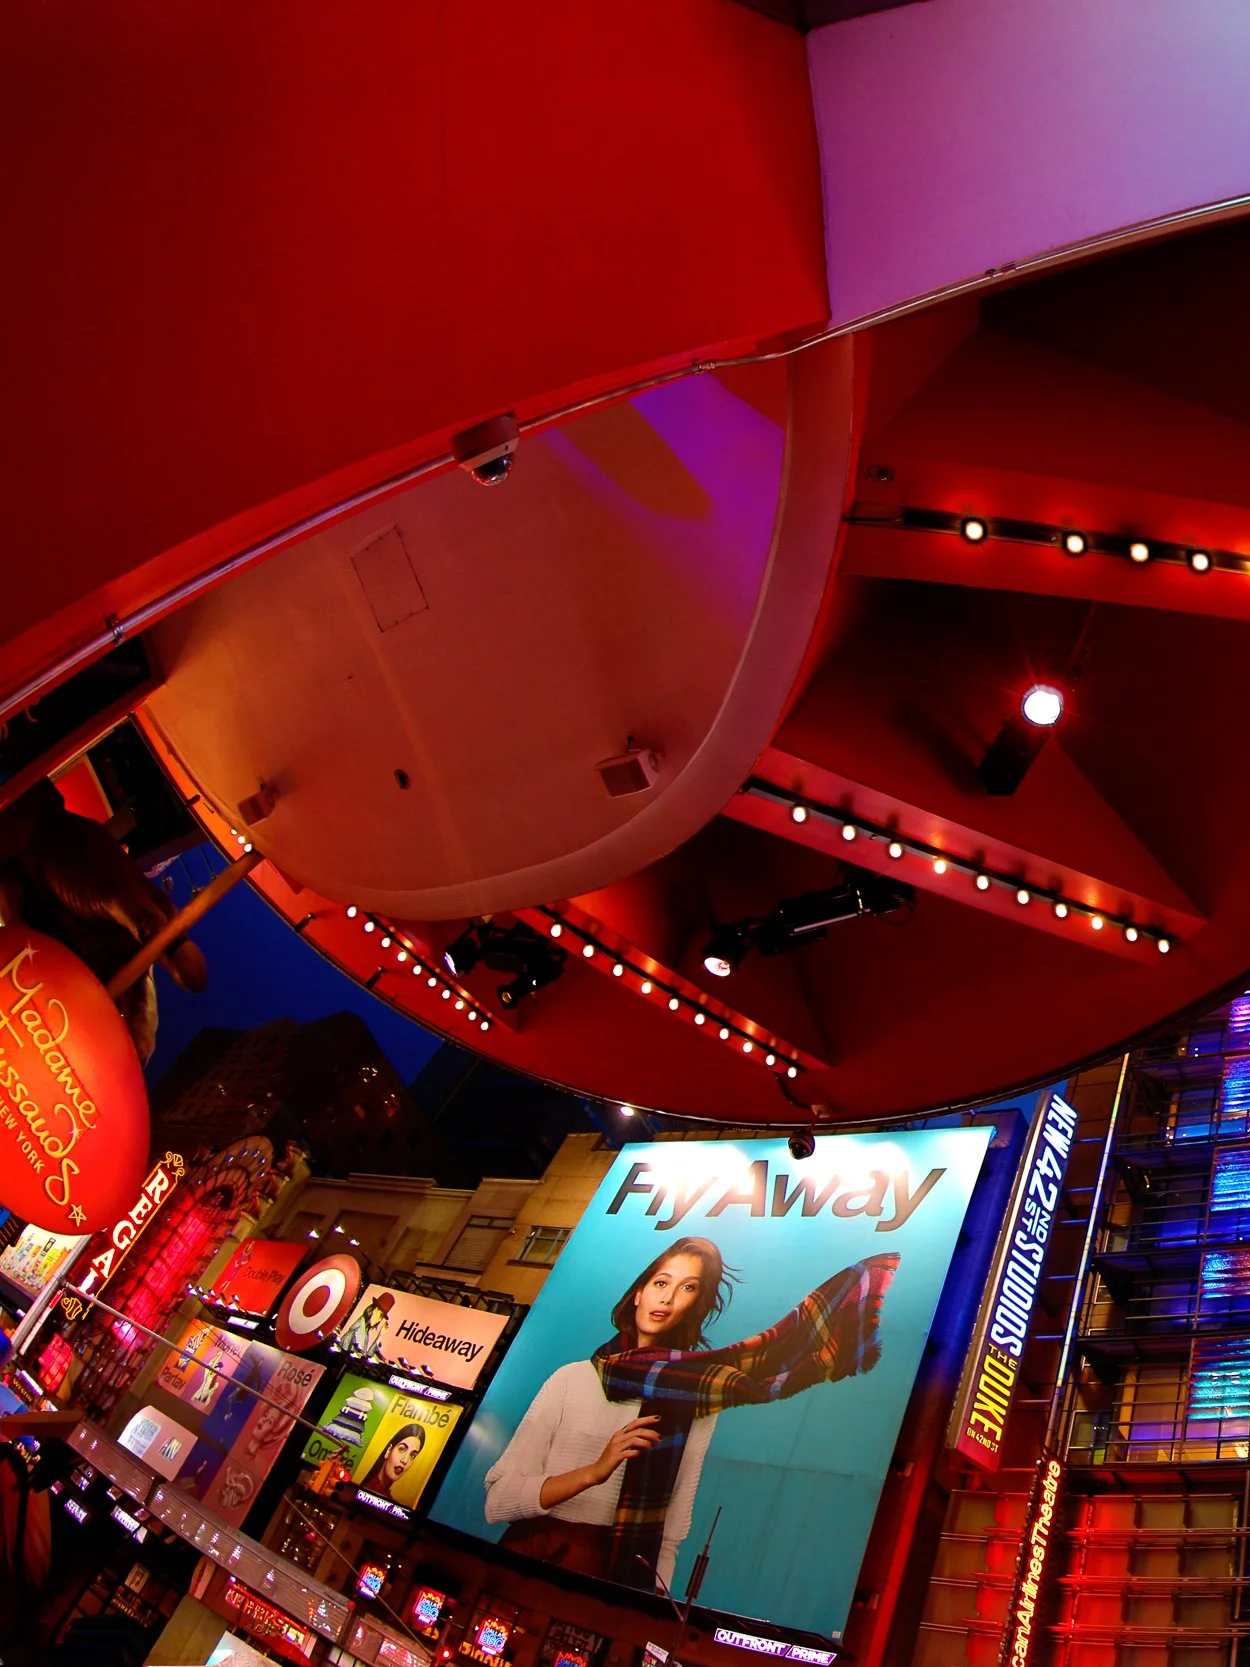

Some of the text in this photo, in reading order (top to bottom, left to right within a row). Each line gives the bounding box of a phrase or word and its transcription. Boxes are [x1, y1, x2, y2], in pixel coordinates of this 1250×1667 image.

[0, 947, 97, 1129] Madame
[0, 1010, 80, 1206] ssauds
[1043, 1094, 1078, 1159] NEW
[16, 1133, 45, 1174] YORK
[77, 1168, 169, 1299] REGAL
[990, 1230, 1044, 1357] STUDIOS
[395, 1319, 484, 1363] Hideaway
[161, 1366, 188, 1392] Partay
[277, 1360, 316, 1388] Rosé
[970, 1343, 1018, 1441] THE DUKE
[390, 1395, 451, 1429] Flambé
[308, 1438, 357, 1470] Omé
[966, 1426, 977, 1441] ON
[718, 1629, 832, 1663] OUTFRONT PRIME
